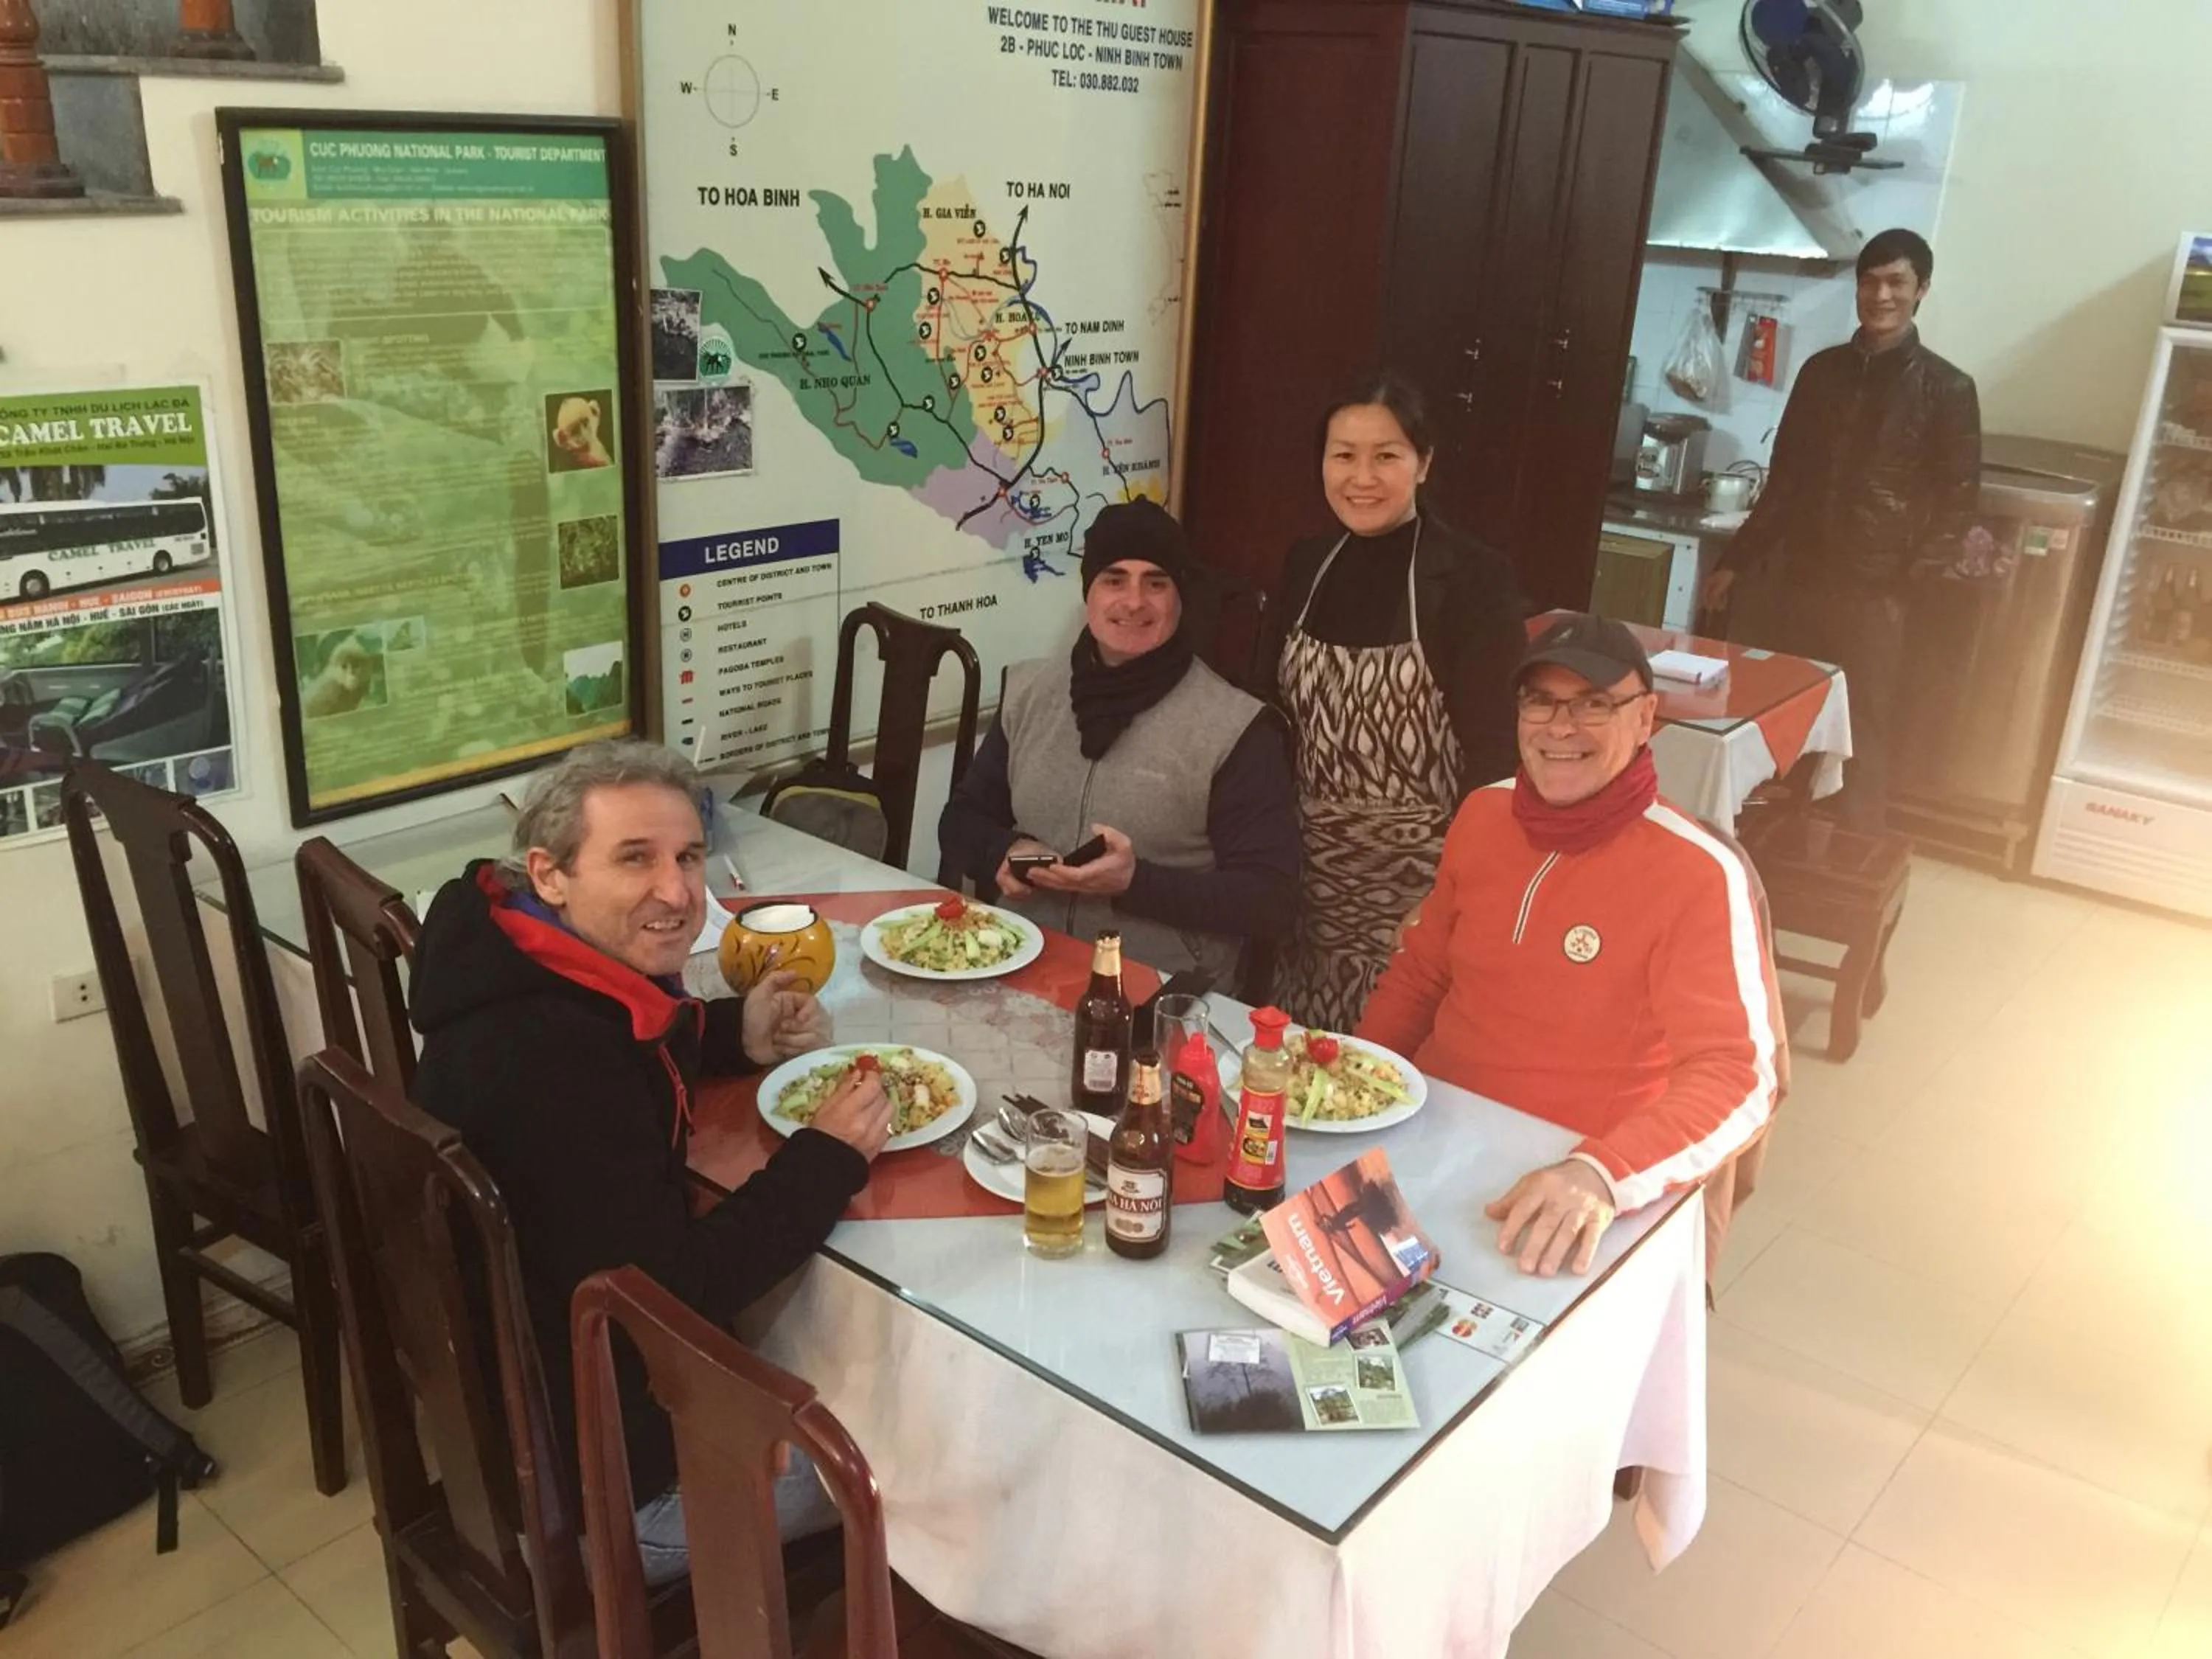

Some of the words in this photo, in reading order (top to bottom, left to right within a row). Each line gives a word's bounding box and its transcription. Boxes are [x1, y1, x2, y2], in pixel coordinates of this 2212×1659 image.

[728, 24, 737, 36] N
[988, 6, 1048, 30] WELCOME
[1053, 15, 1068, 33] TO
[1071, 17, 1093, 36] THE
[1096, 21, 1118, 38] THU
[1121, 24, 1156, 43] GUEST
[1158, 29, 1193, 47] HOUSE
[1001, 35, 1015, 53] 2B
[1027, 39, 1060, 58] PHUC
[1062, 43, 1085, 61] LOC
[1095, 46, 1121, 65] NINH
[1124, 49, 1150, 67] BINH
[1153, 52, 1183, 71] TOWN
[681, 82, 693, 94] W
[1051, 69, 1077, 88] TEL:
[771, 88, 779, 100] E
[309, 142, 337, 158] CUC
[339, 142, 392, 159] PHUONG
[393, 144, 453, 159] NATIONAL
[455, 145, 485, 160] PARK
[494, 146, 537, 161] TOURIST
[540, 147, 605, 163] DEPARTMENT
[729, 144, 738, 156] S
[697, 186, 720, 206] TO
[724, 187, 759, 207] HOA
[763, 189, 800, 207] BINH
[1006, 181, 1024, 198] TO
[1027, 182, 1046, 199] HA
[1049, 182, 1071, 199] NOI
[251, 208, 333, 224] TOURISM
[338, 207, 431, 223] ACTIVITIES
[434, 207, 451, 223] IN
[455, 207, 484, 222] THE
[936, 207, 953, 219] GIA
[1065, 323, 1078, 334] TO
[1080, 321, 1100, 334] NAM
[1103, 320, 1124, 332] DINH
[1065, 355, 1086, 367] NINH
[1089, 352, 1110, 365] BINH
[1114, 351, 1139, 364] TOWN
[814, 377, 838, 389] NHO
[841, 375, 871, 388] QUAN
[0, 420, 85, 447] CAMEL
[89, 412, 192, 439] TRAVEL
[47, 545, 100, 562] CAMEL
[108, 538, 156, 554] TRAVEL
[705, 538, 779, 564] LEGEND
[717, 576, 747, 588] CENTRE
[748, 574, 759, 582] OF
[760, 568, 793, 581] DISTRICT
[795, 566, 810, 575] AND
[920, 607, 934, 619] TO
[937, 599, 973, 617] THANH
[975, 594, 998, 608] HOA
[717, 638, 767, 653] RESTAURANT
[751, 655, 784, 668] TEMPLES
[719, 684, 740, 696] WAYS
[742, 683, 753, 692] TO
[786, 669, 813, 681] PLACES
[2085, 801, 2156, 826] SANAKY
[1287, 1212, 1346, 1306] Vietnam
